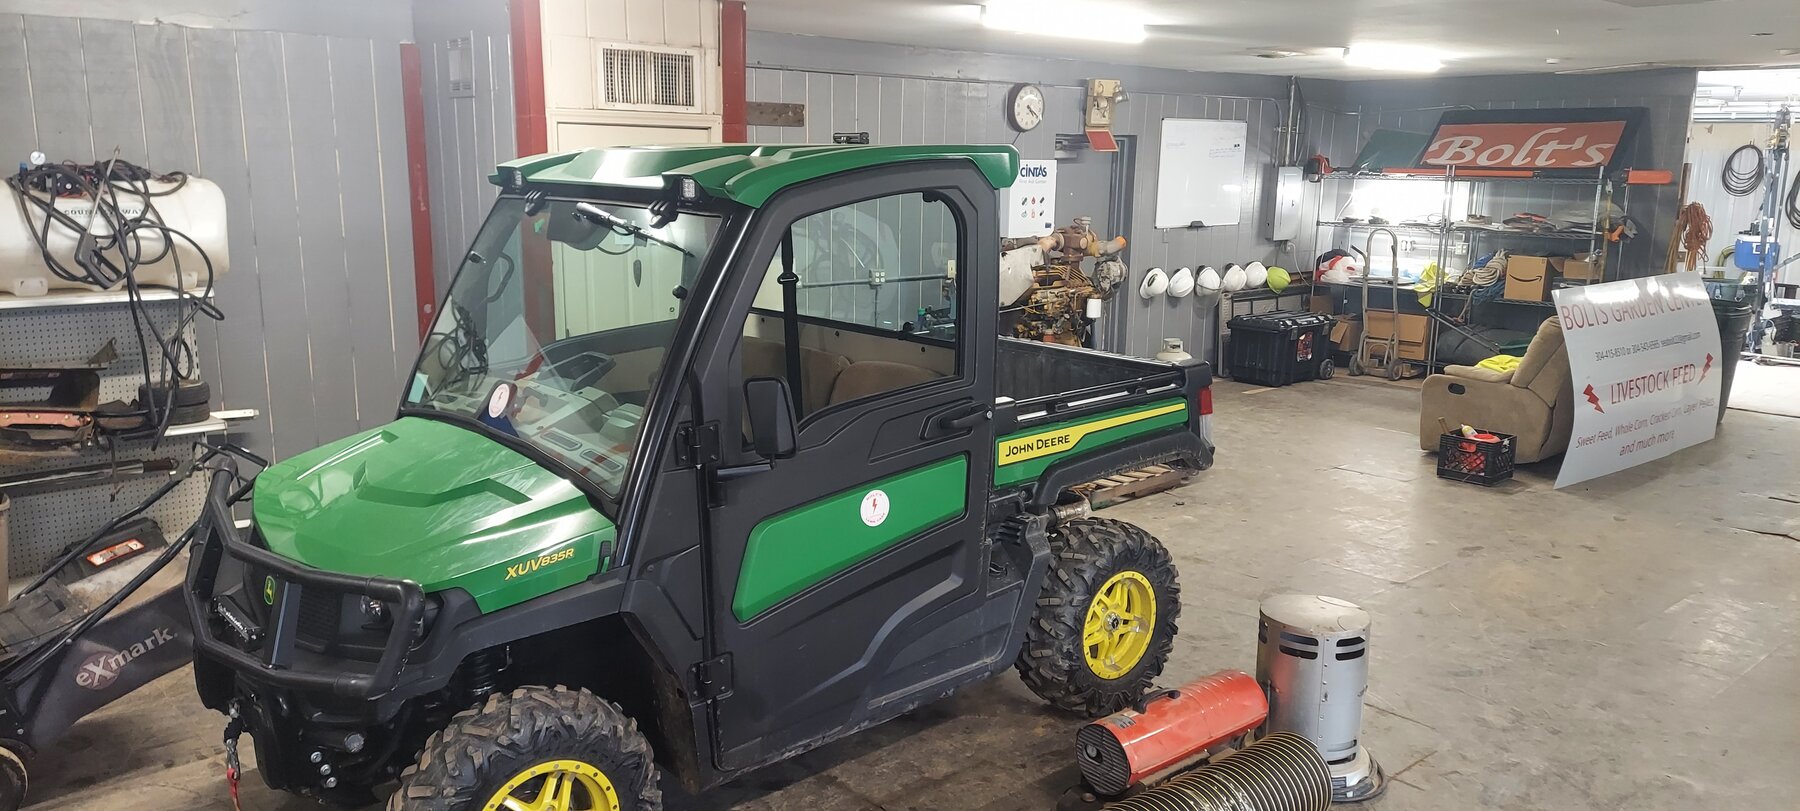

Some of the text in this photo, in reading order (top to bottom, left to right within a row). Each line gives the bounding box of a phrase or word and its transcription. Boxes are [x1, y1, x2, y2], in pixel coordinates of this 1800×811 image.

[1425, 127, 1617, 166] Bolt's
[1020, 164, 1047, 177] CINTAS
[1611, 293, 1664, 322] GARDEN
[1611, 363, 1696, 404] LIVESTOCK FEED
[1005, 434, 1071, 457] JOHN DEERE
[1576, 435, 1596, 449] Sweet
[1615, 422, 1633, 436] Whole
[1620, 430, 1675, 456] and much more
